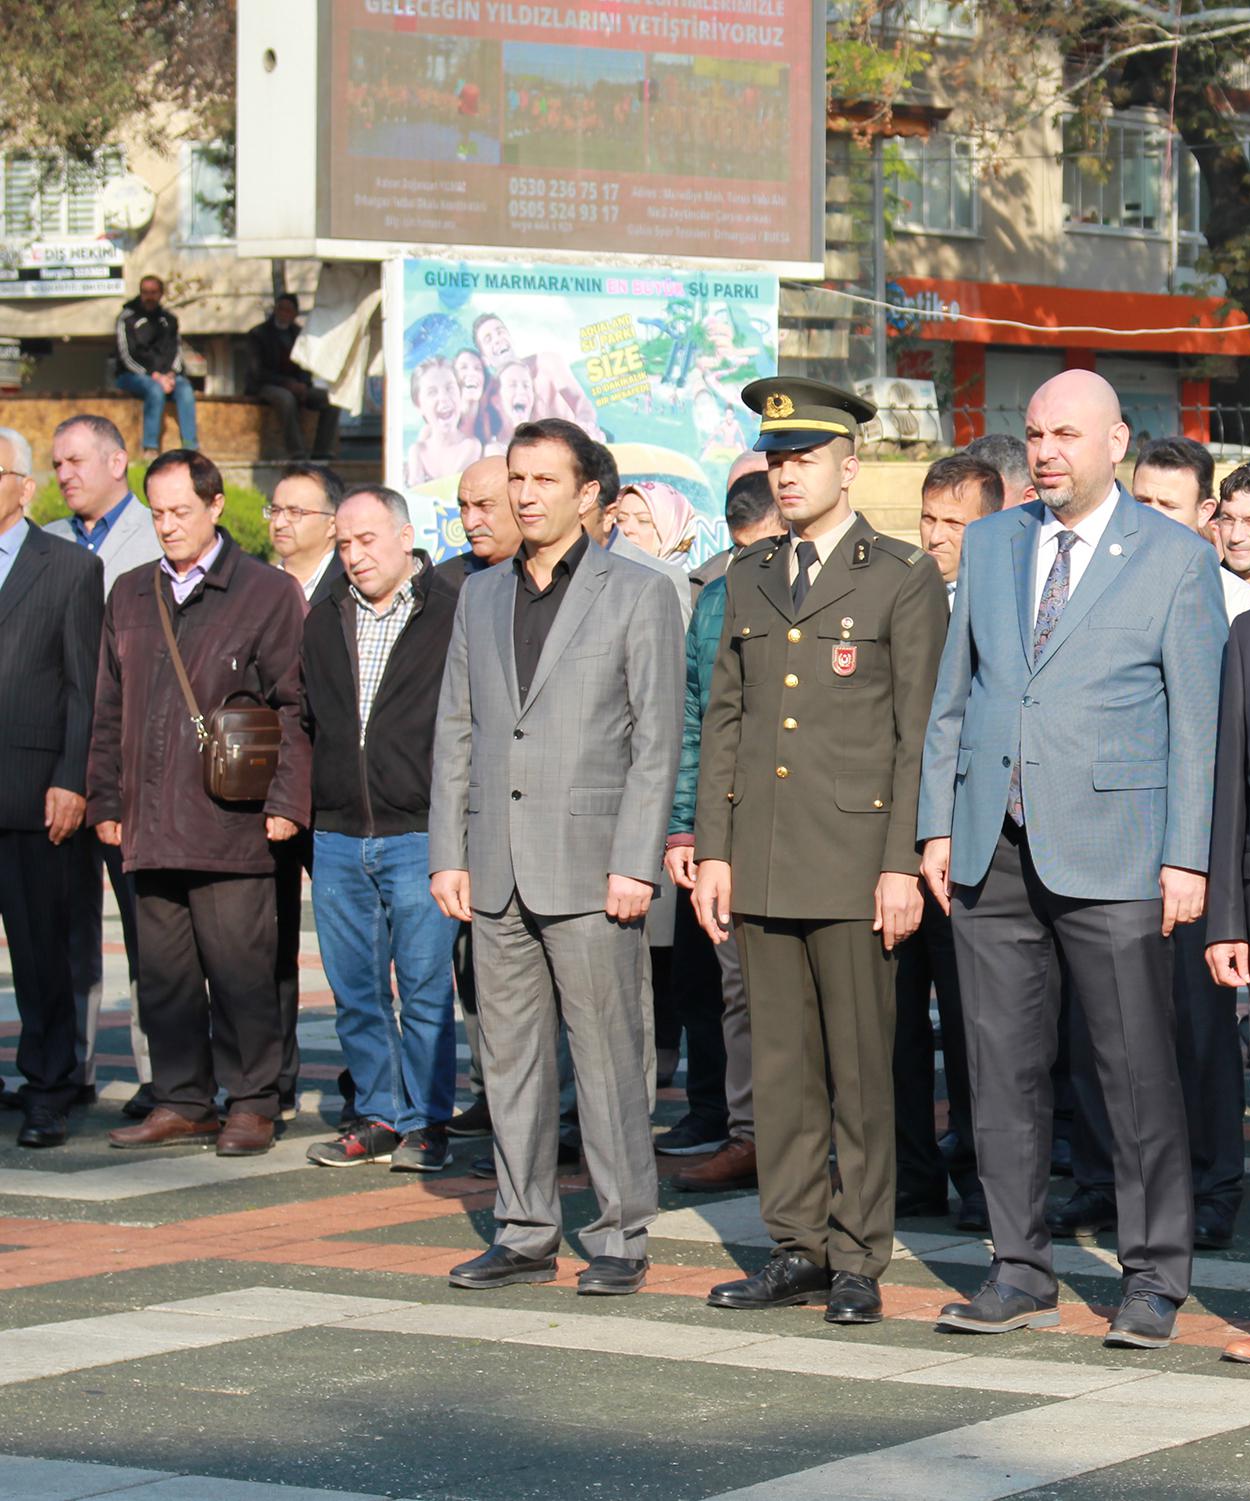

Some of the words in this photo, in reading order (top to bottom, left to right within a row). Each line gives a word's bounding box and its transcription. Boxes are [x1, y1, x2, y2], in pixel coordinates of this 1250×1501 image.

[486, 3, 622, 33] YILDIZLARINI
[627, 12, 784, 47] YETİŞTİRİYORUZ
[509, 177, 545, 197] 0530
[549, 178, 577, 199] 236
[580, 180, 598, 201] 75
[602, 182, 620, 202] 17
[509, 199, 545, 219] 0505
[549, 201, 577, 221] 524
[602, 204, 620, 224] 17
[425, 267, 480, 289] GÜNEY
[485, 272, 602, 293] MARMARA'NIN
[606, 278, 628, 295] EN
[688, 281, 709, 297] SU
[714, 282, 760, 299] PARKI
[585, 343, 644, 383] SİZE
